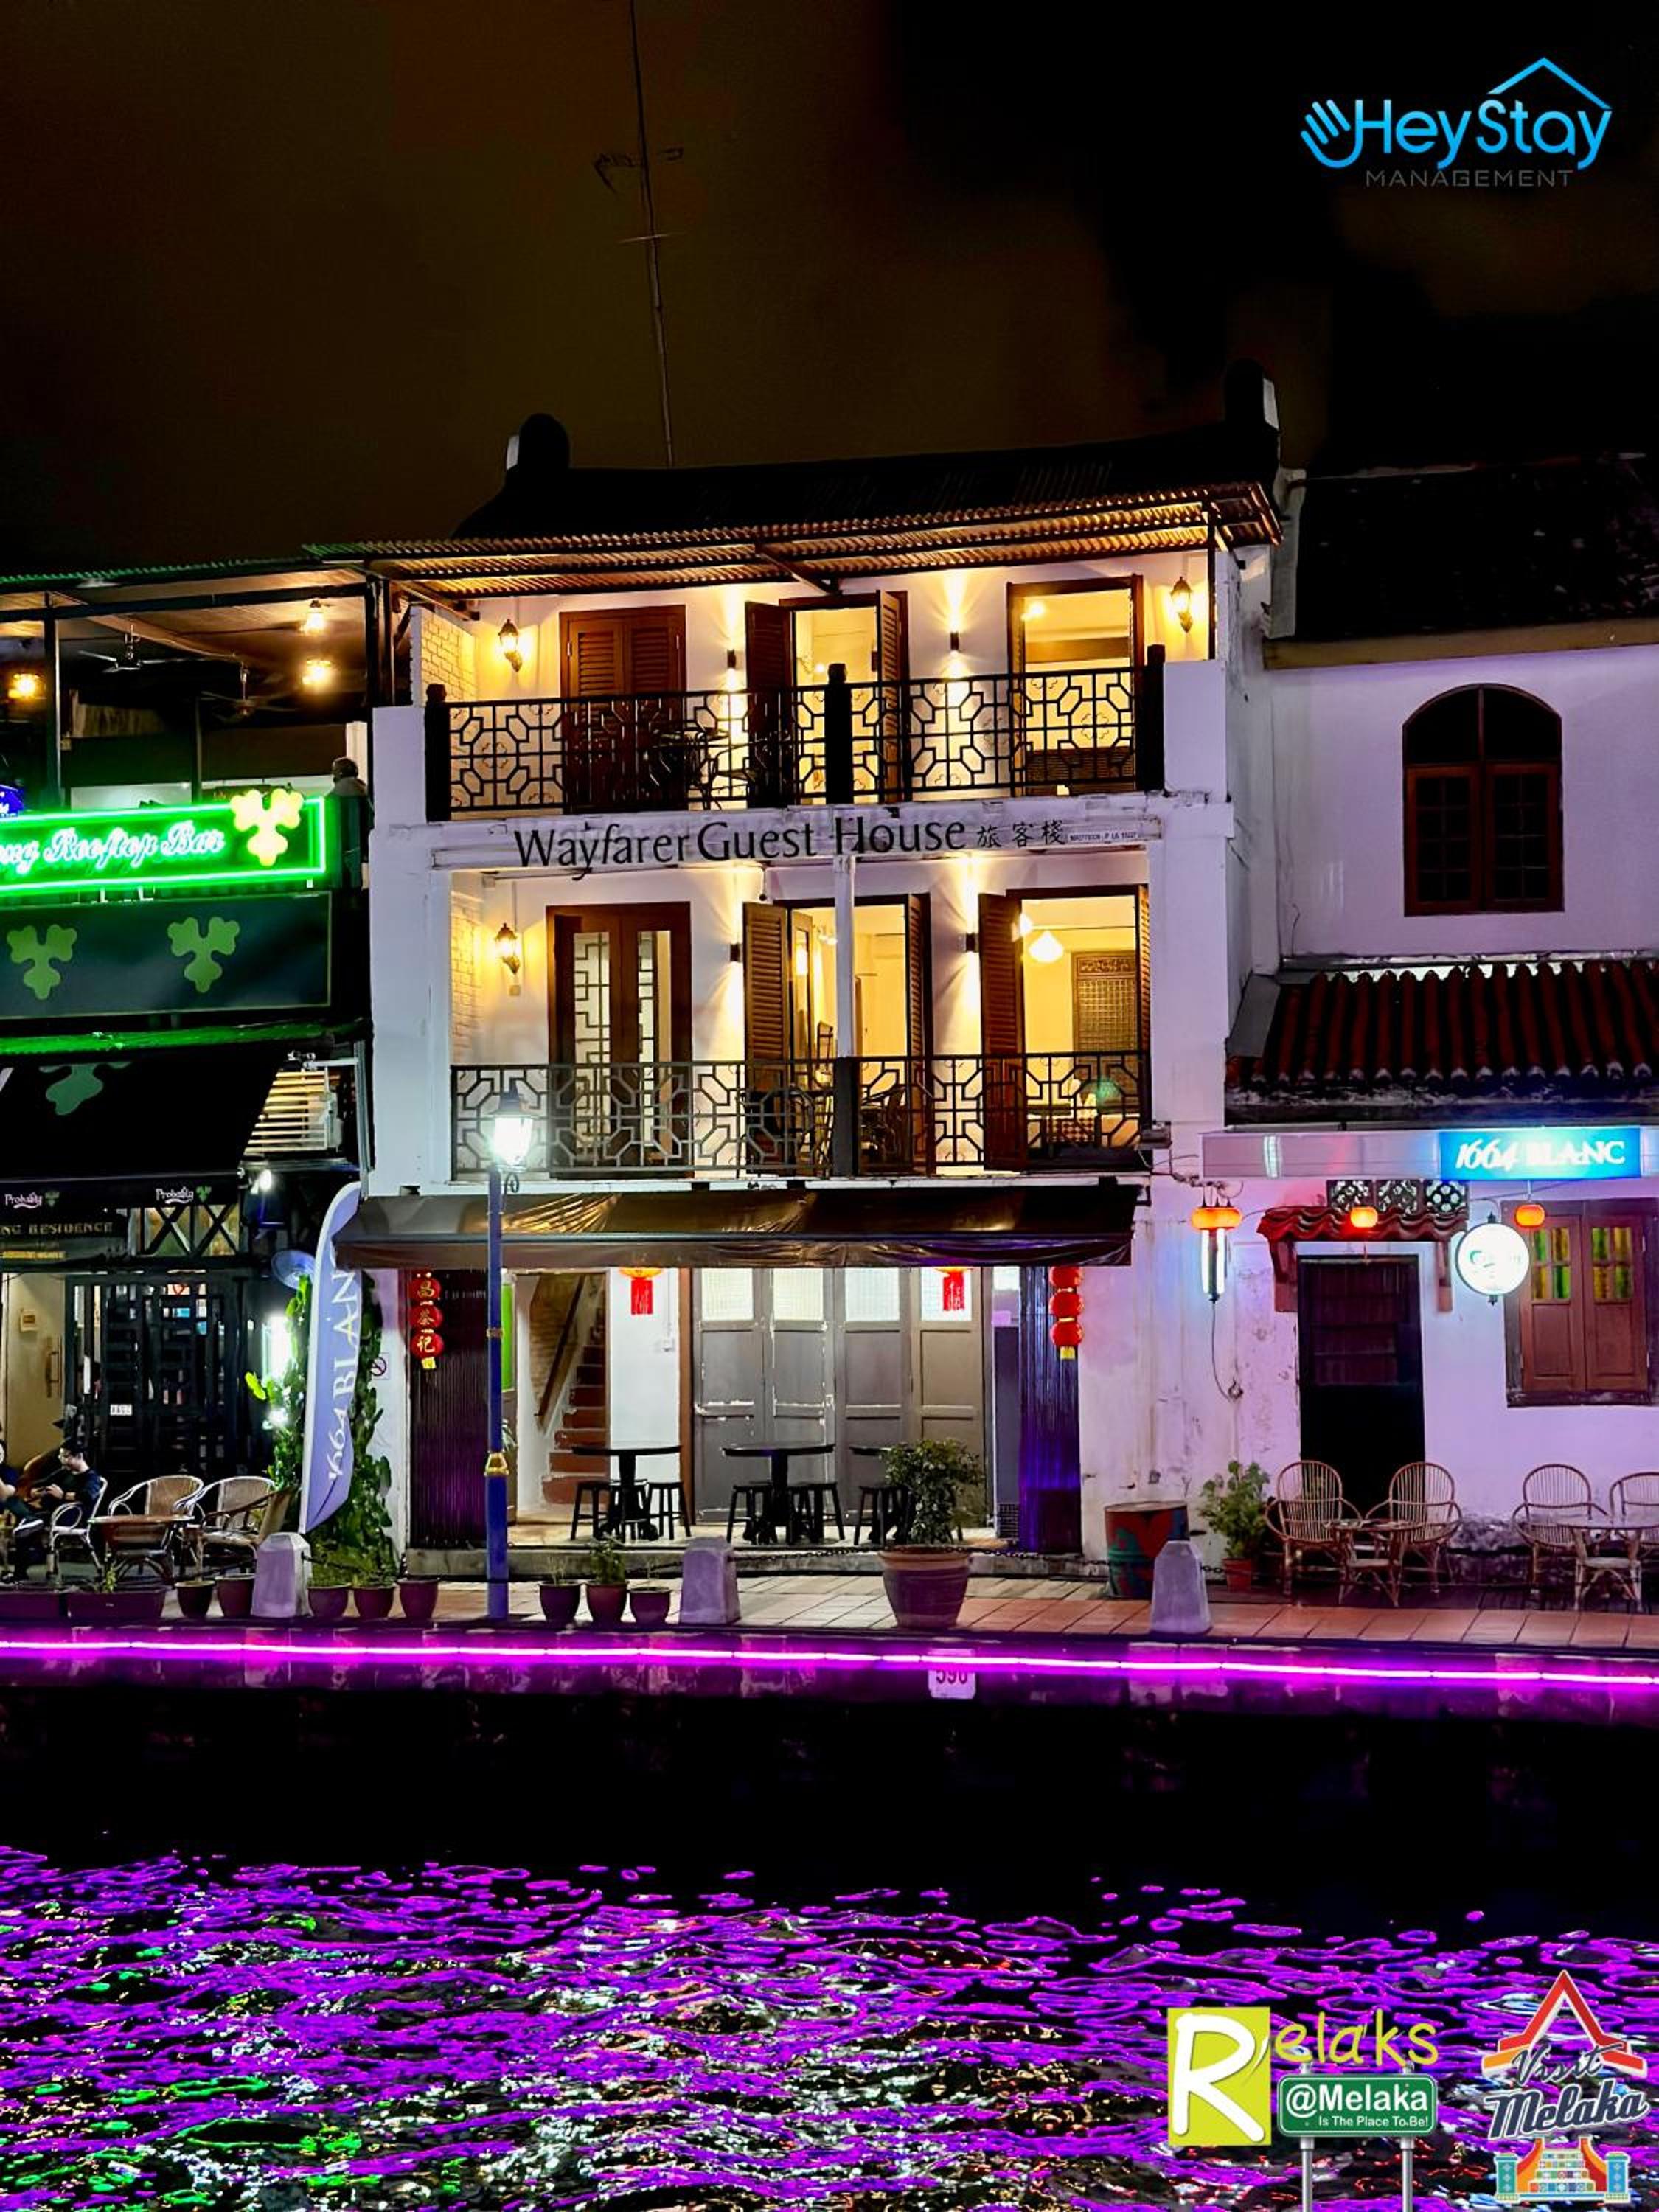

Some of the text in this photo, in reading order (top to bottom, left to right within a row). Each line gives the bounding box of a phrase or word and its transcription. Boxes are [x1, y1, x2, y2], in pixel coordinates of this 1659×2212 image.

[44, 827, 158, 869] Rooftop
[161, 819, 225, 855] Bar
[514, 816, 965, 880] Wayfarer Guest House
[977, 818, 1065, 849] 旅客棧
[1455, 1139, 1626, 1171] 1664 BLANC
[29, 1222, 113, 1235] RESIDENCE
